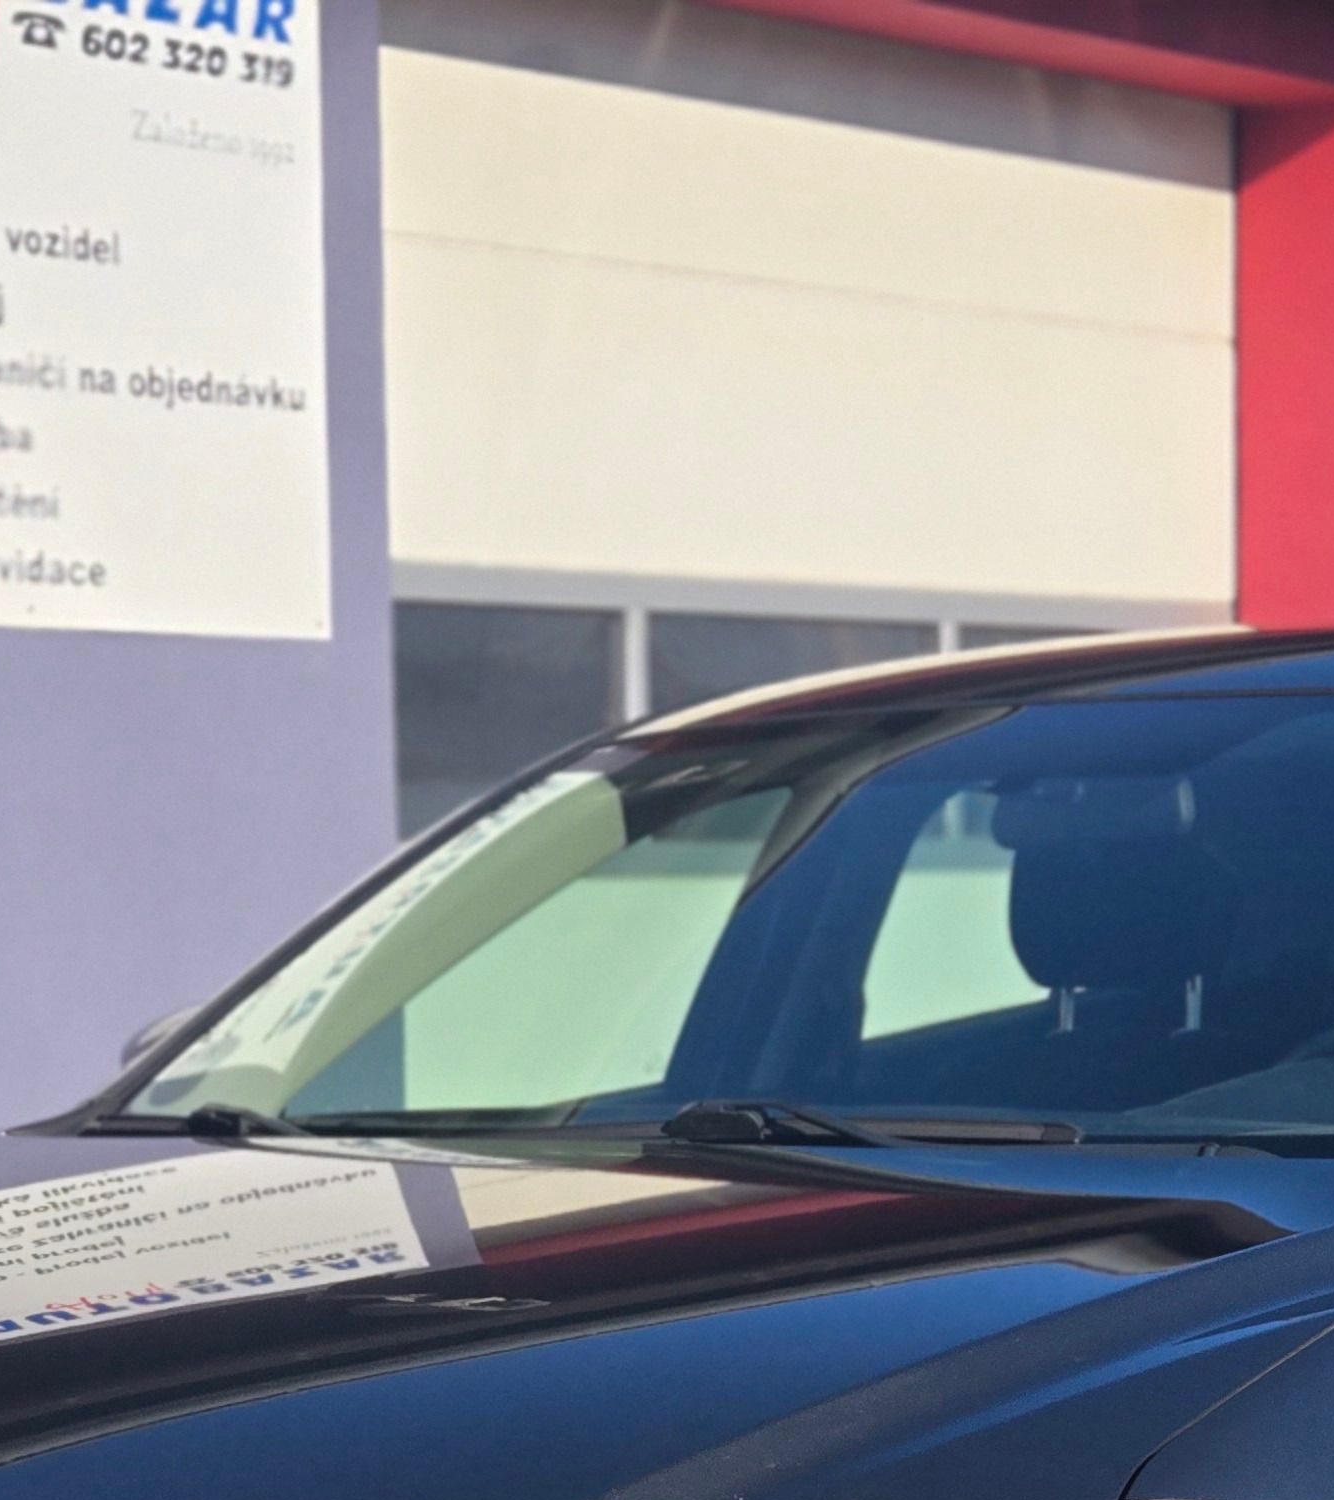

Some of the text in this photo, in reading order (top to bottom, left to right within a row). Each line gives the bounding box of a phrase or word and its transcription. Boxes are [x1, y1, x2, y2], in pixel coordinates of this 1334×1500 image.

[81, 24, 294, 88] 602 320 319
[5, 224, 120, 266] vozidel
[79, 366, 116, 394] na
[128, 364, 307, 411] objednávku
